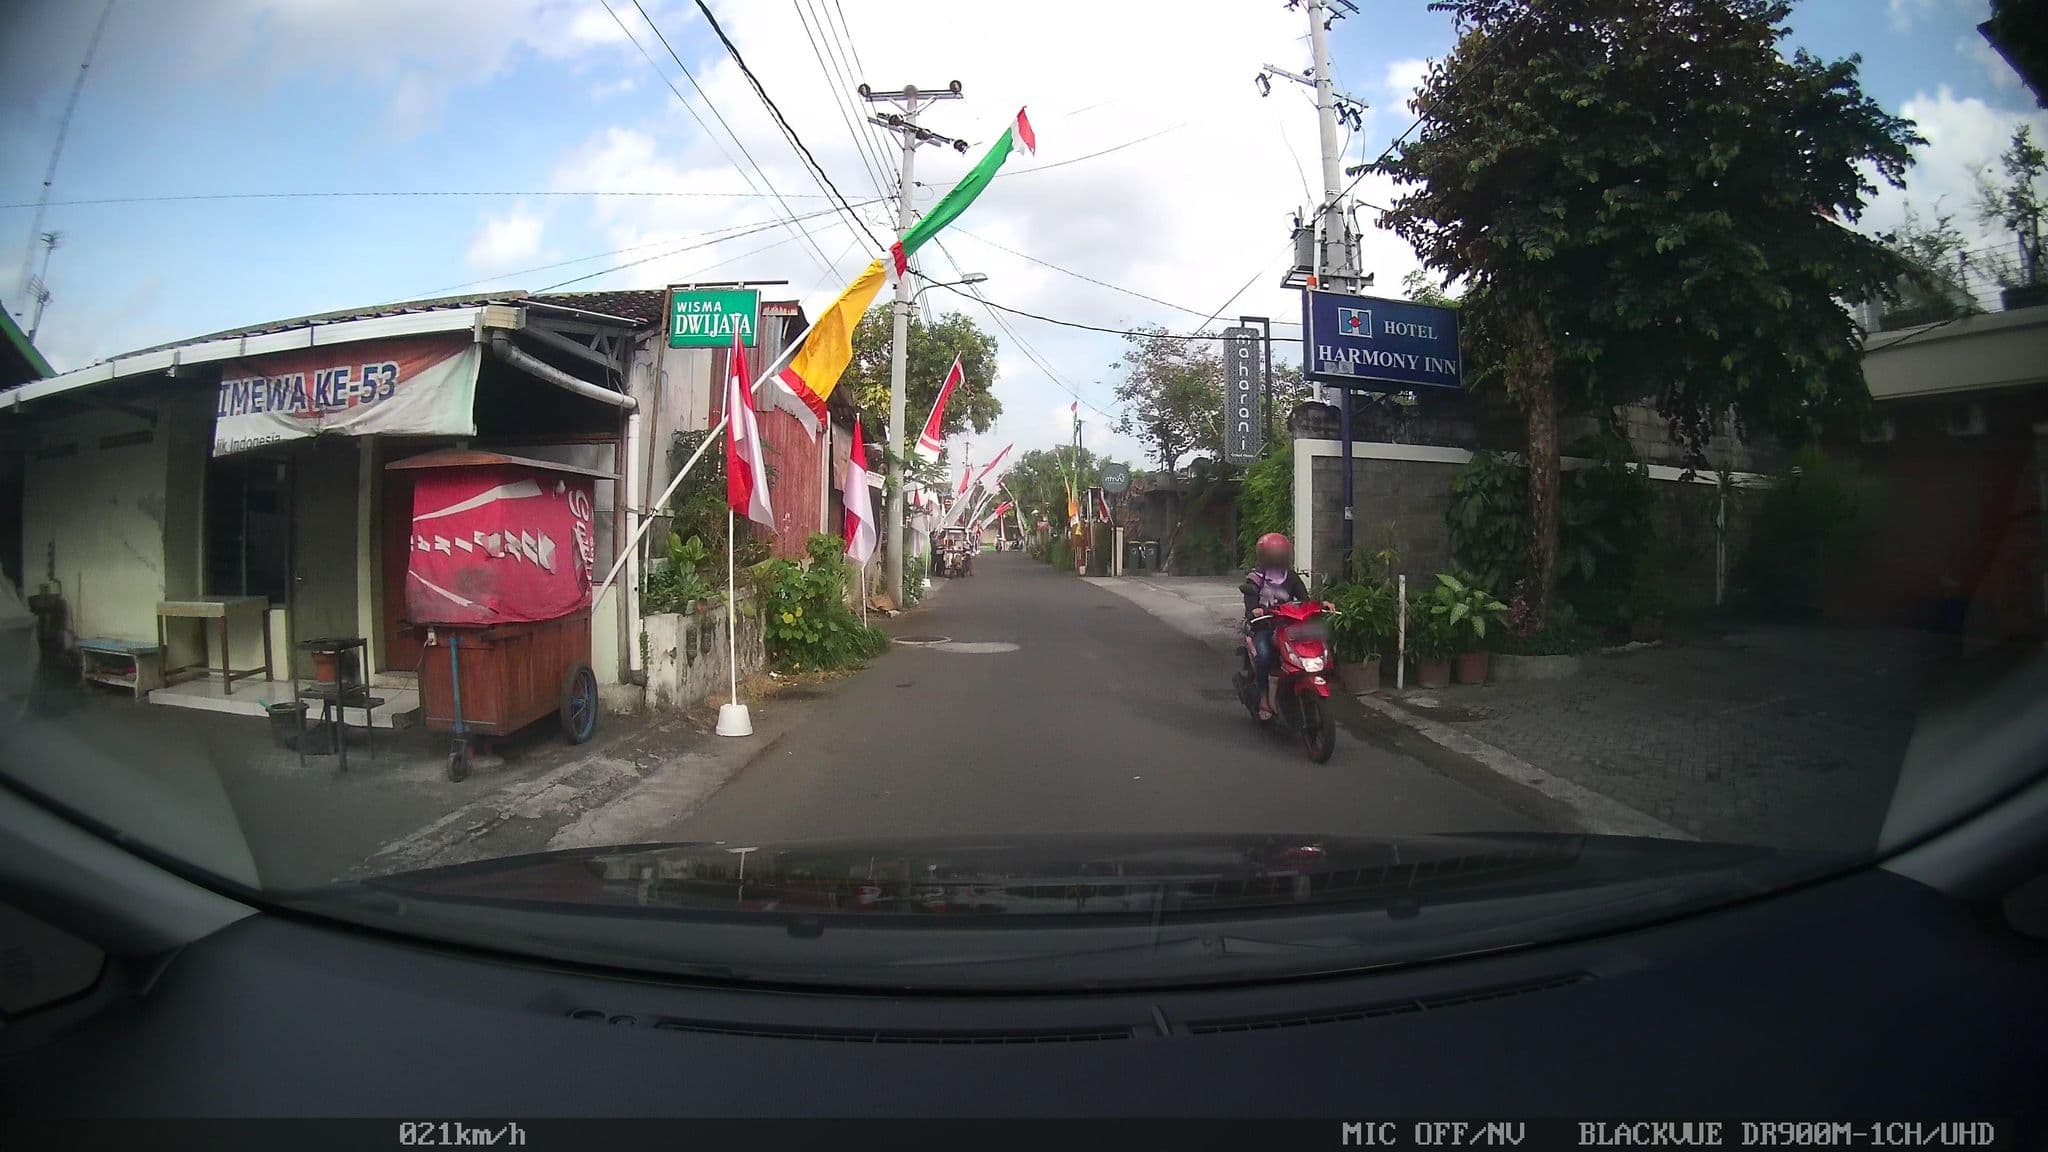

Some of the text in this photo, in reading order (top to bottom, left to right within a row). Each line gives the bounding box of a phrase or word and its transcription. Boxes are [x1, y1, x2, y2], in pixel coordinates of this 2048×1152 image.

[676, 301, 722, 313] WISMA
[675, 313, 752, 338] DWIJAYA
[1384, 320, 1438, 340] HOTEL
[1318, 344, 1457, 376] HARMONY INN
[314, 364, 397, 407] KE-53
[1236, 334, 1250, 450] maharani
[231, 431, 281, 454] Indonesia
